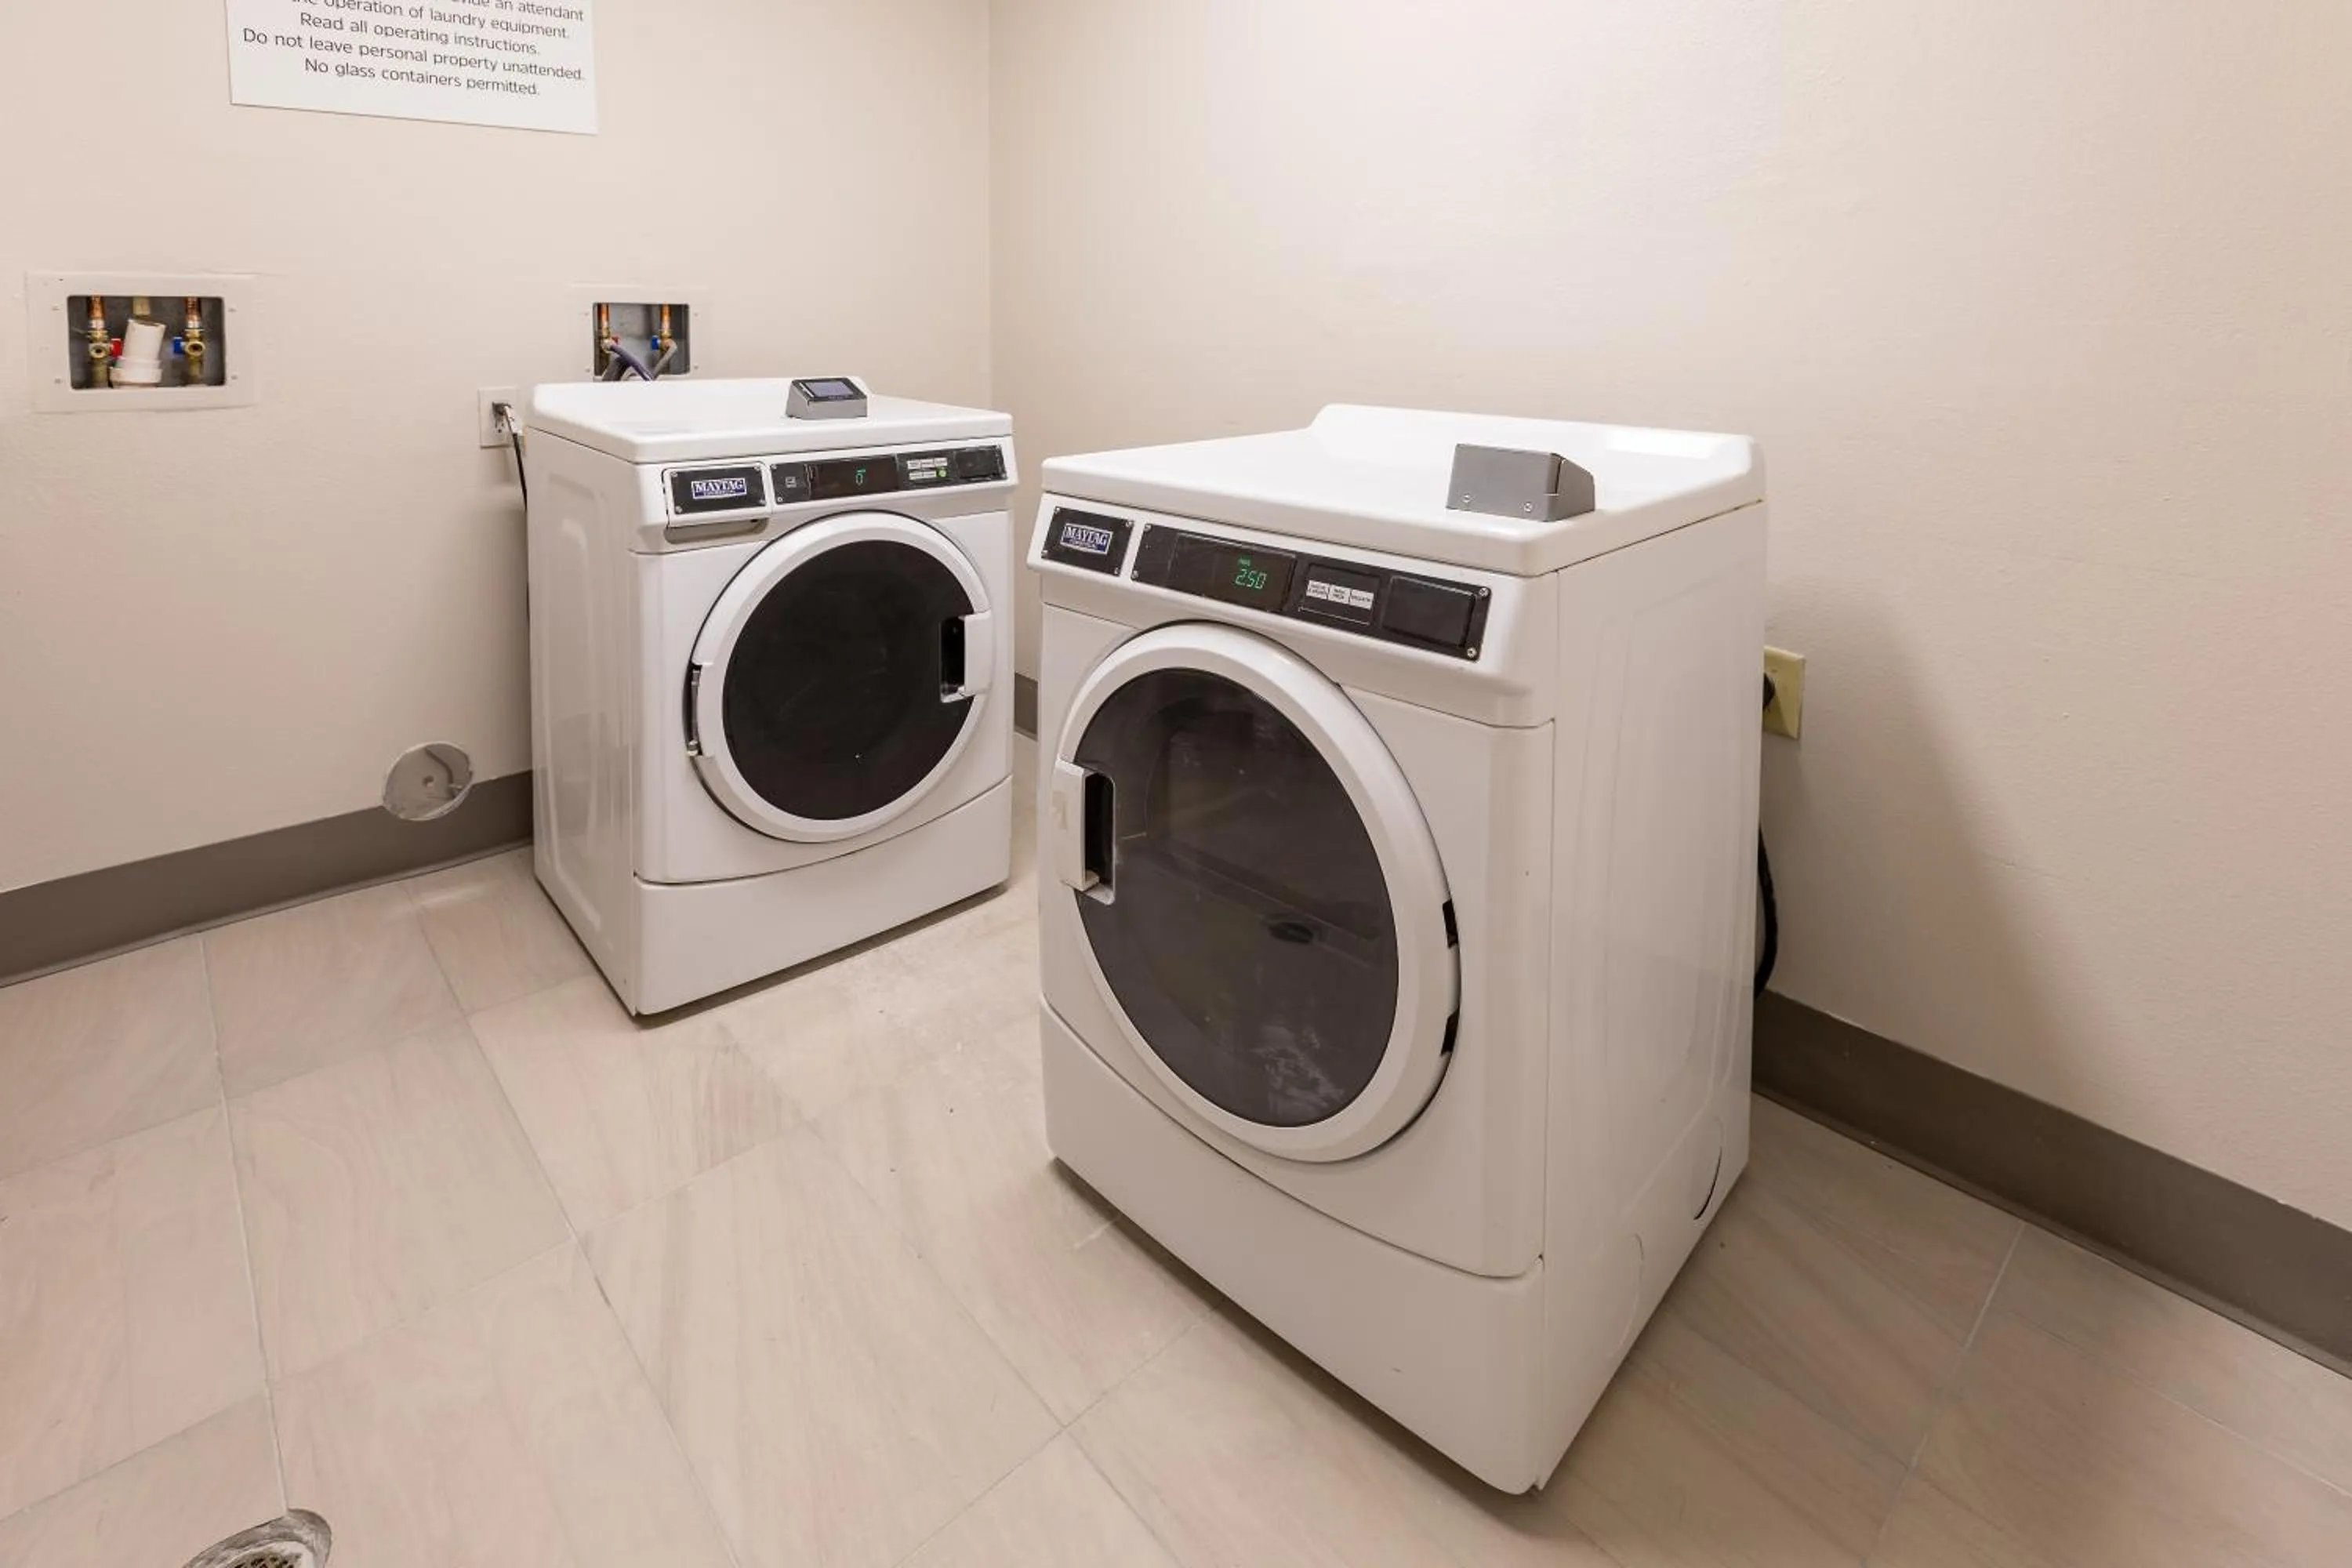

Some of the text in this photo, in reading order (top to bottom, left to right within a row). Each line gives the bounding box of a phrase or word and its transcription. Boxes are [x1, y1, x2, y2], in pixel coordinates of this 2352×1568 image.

[325, 0, 570, 38] operation of laundry equipment.
[495, 0, 514, 9] an
[518, 2, 584, 21] attendant
[300, 12, 539, 55] Read all operating instructions.
[244, 27, 585, 80] Do not leave personal property unattended.
[304, 57, 540, 95] No glass containers permitted.
[694, 479, 744, 493] MAYTAG
[1062, 526, 1109, 546] MAYTAG
